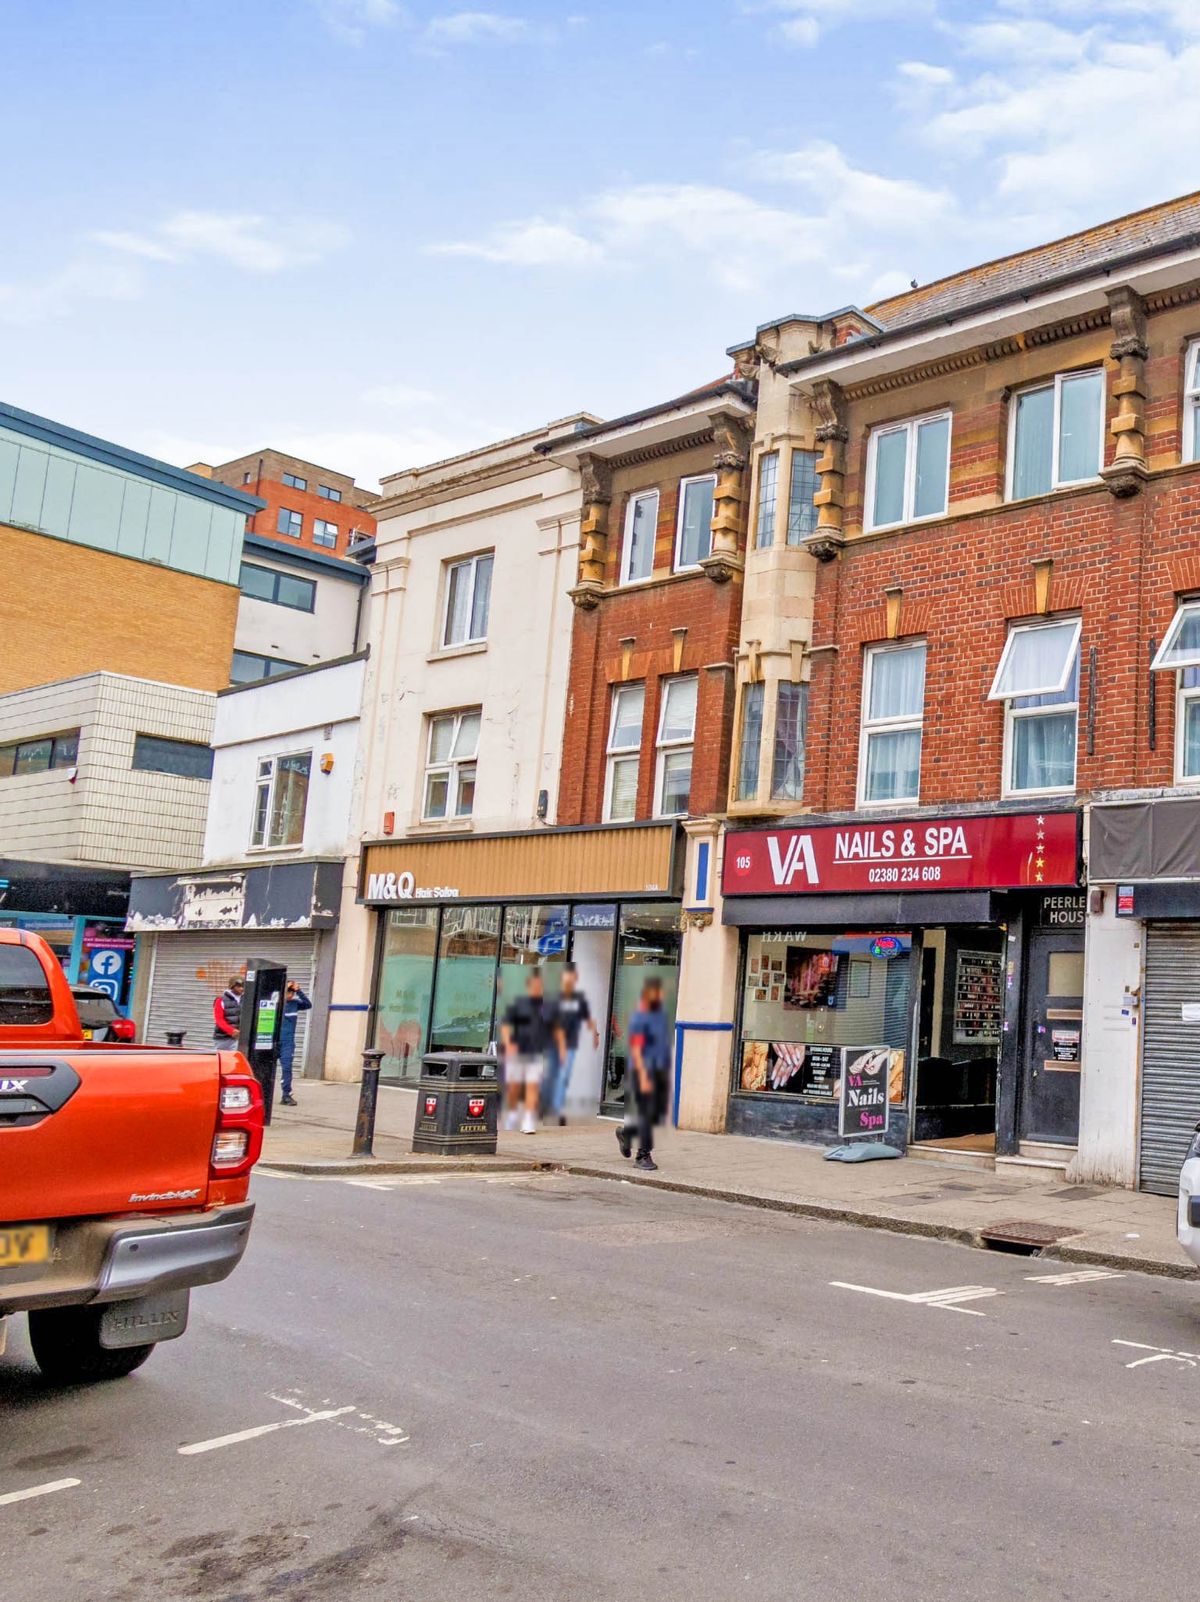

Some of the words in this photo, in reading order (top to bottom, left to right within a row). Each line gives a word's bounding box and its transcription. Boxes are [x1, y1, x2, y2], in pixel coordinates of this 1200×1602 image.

[834, 830, 895, 860] NAILS
[900, 828, 916, 857] &
[924, 826, 968, 856] SPA
[736, 856, 751, 869] 105
[766, 834, 820, 886] VA
[868, 867, 898, 883] 02380
[900, 866, 920, 882] 234
[922, 866, 941, 881] 608
[368, 871, 415, 900] M&Q
[416, 887, 434, 898] Hair
[433, 886, 460, 898] Salon
[1043, 896, 1086, 909] PEERLE
[1050, 911, 1084, 924] HOUS
[847, 1087, 885, 1107] Nails
[460, 1125, 487, 1133] LITTER
[860, 1111, 884, 1130] Spa
